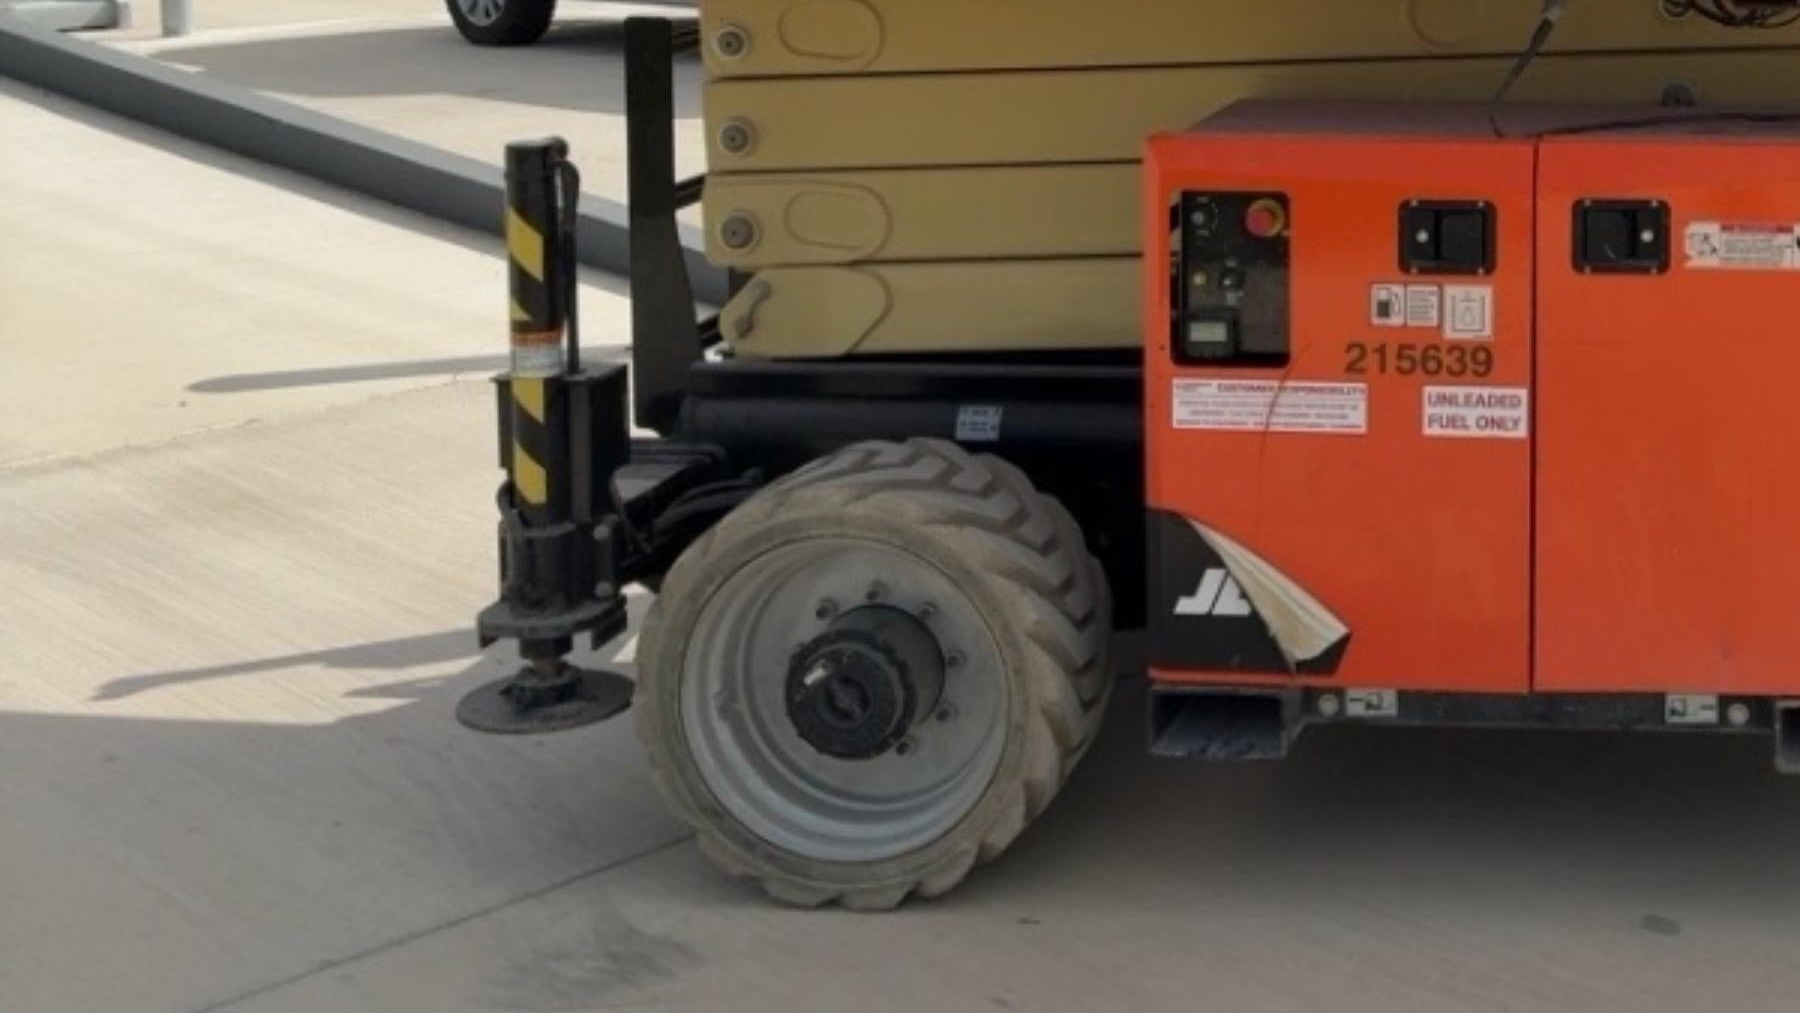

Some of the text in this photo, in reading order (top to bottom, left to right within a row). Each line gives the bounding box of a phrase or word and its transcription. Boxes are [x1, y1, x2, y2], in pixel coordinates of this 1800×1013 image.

[1343, 341, 1495, 378] 215639
[1427, 391, 1522, 409] UNLEADED
[1427, 412, 1522, 431] FUEL ONLY
